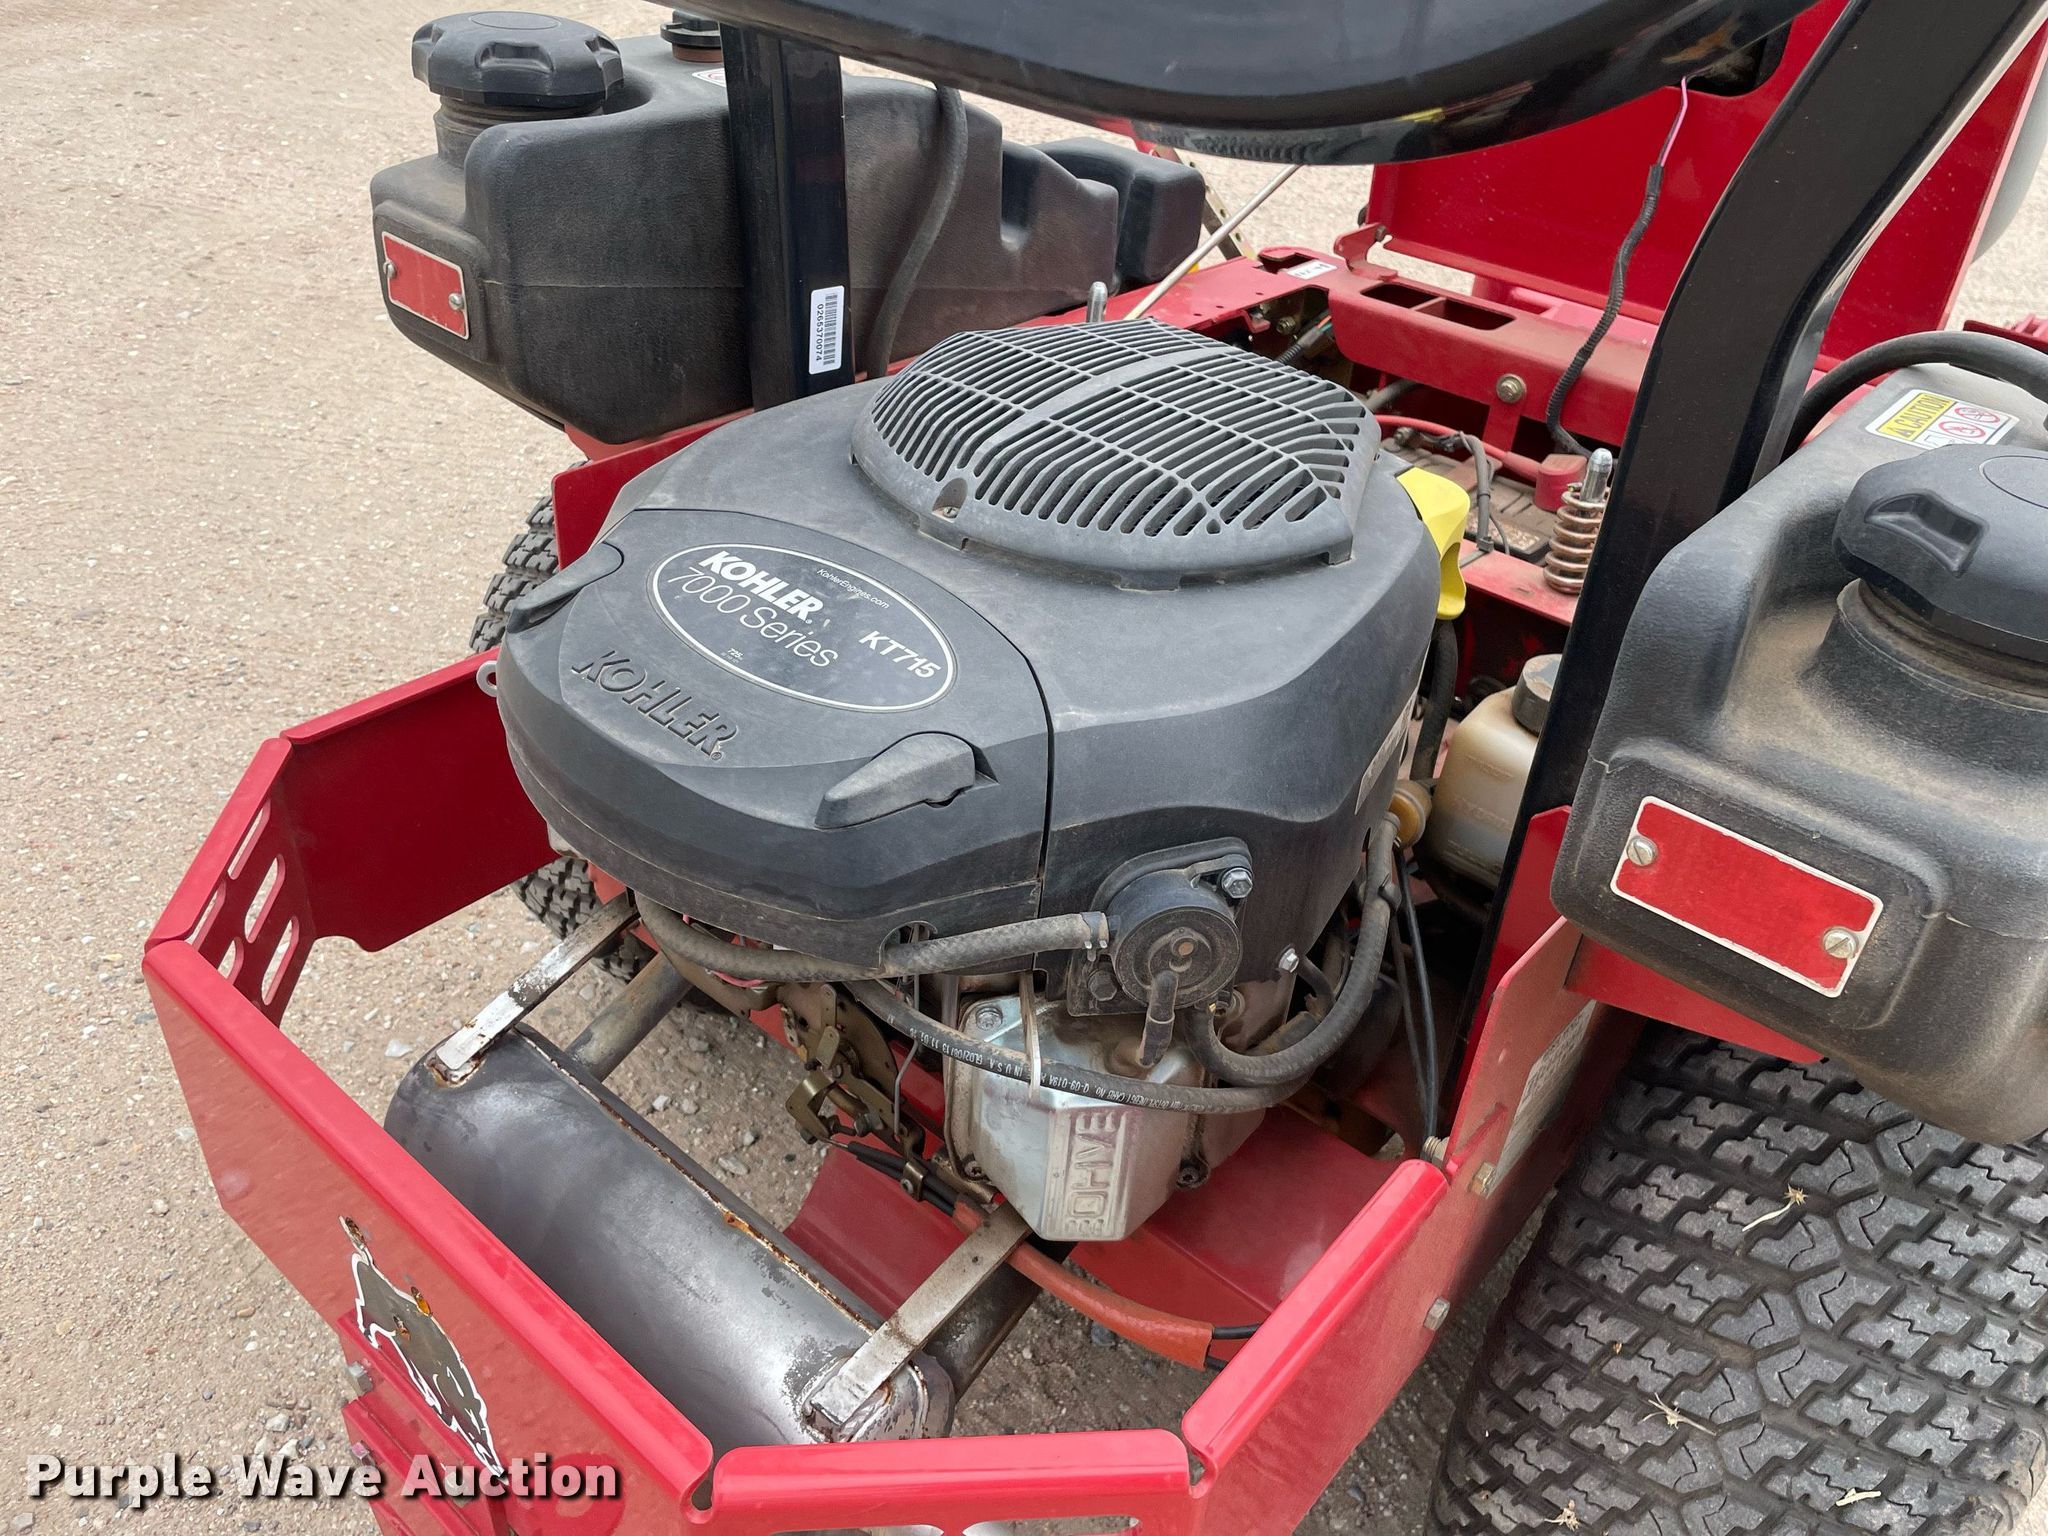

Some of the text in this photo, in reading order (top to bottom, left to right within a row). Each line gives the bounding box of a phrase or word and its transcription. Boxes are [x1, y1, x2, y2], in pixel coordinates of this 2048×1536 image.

[816, 303, 825, 362] 0265370074
[1906, 394, 1952, 429] CAUTION
[698, 550, 824, 622] KOHLER
[817, 568, 890, 609] KohlerEngines.com
[667, 566, 839, 667] 7000 Series
[858, 630, 942, 678] KT715
[571, 650, 738, 757] KOHLER
